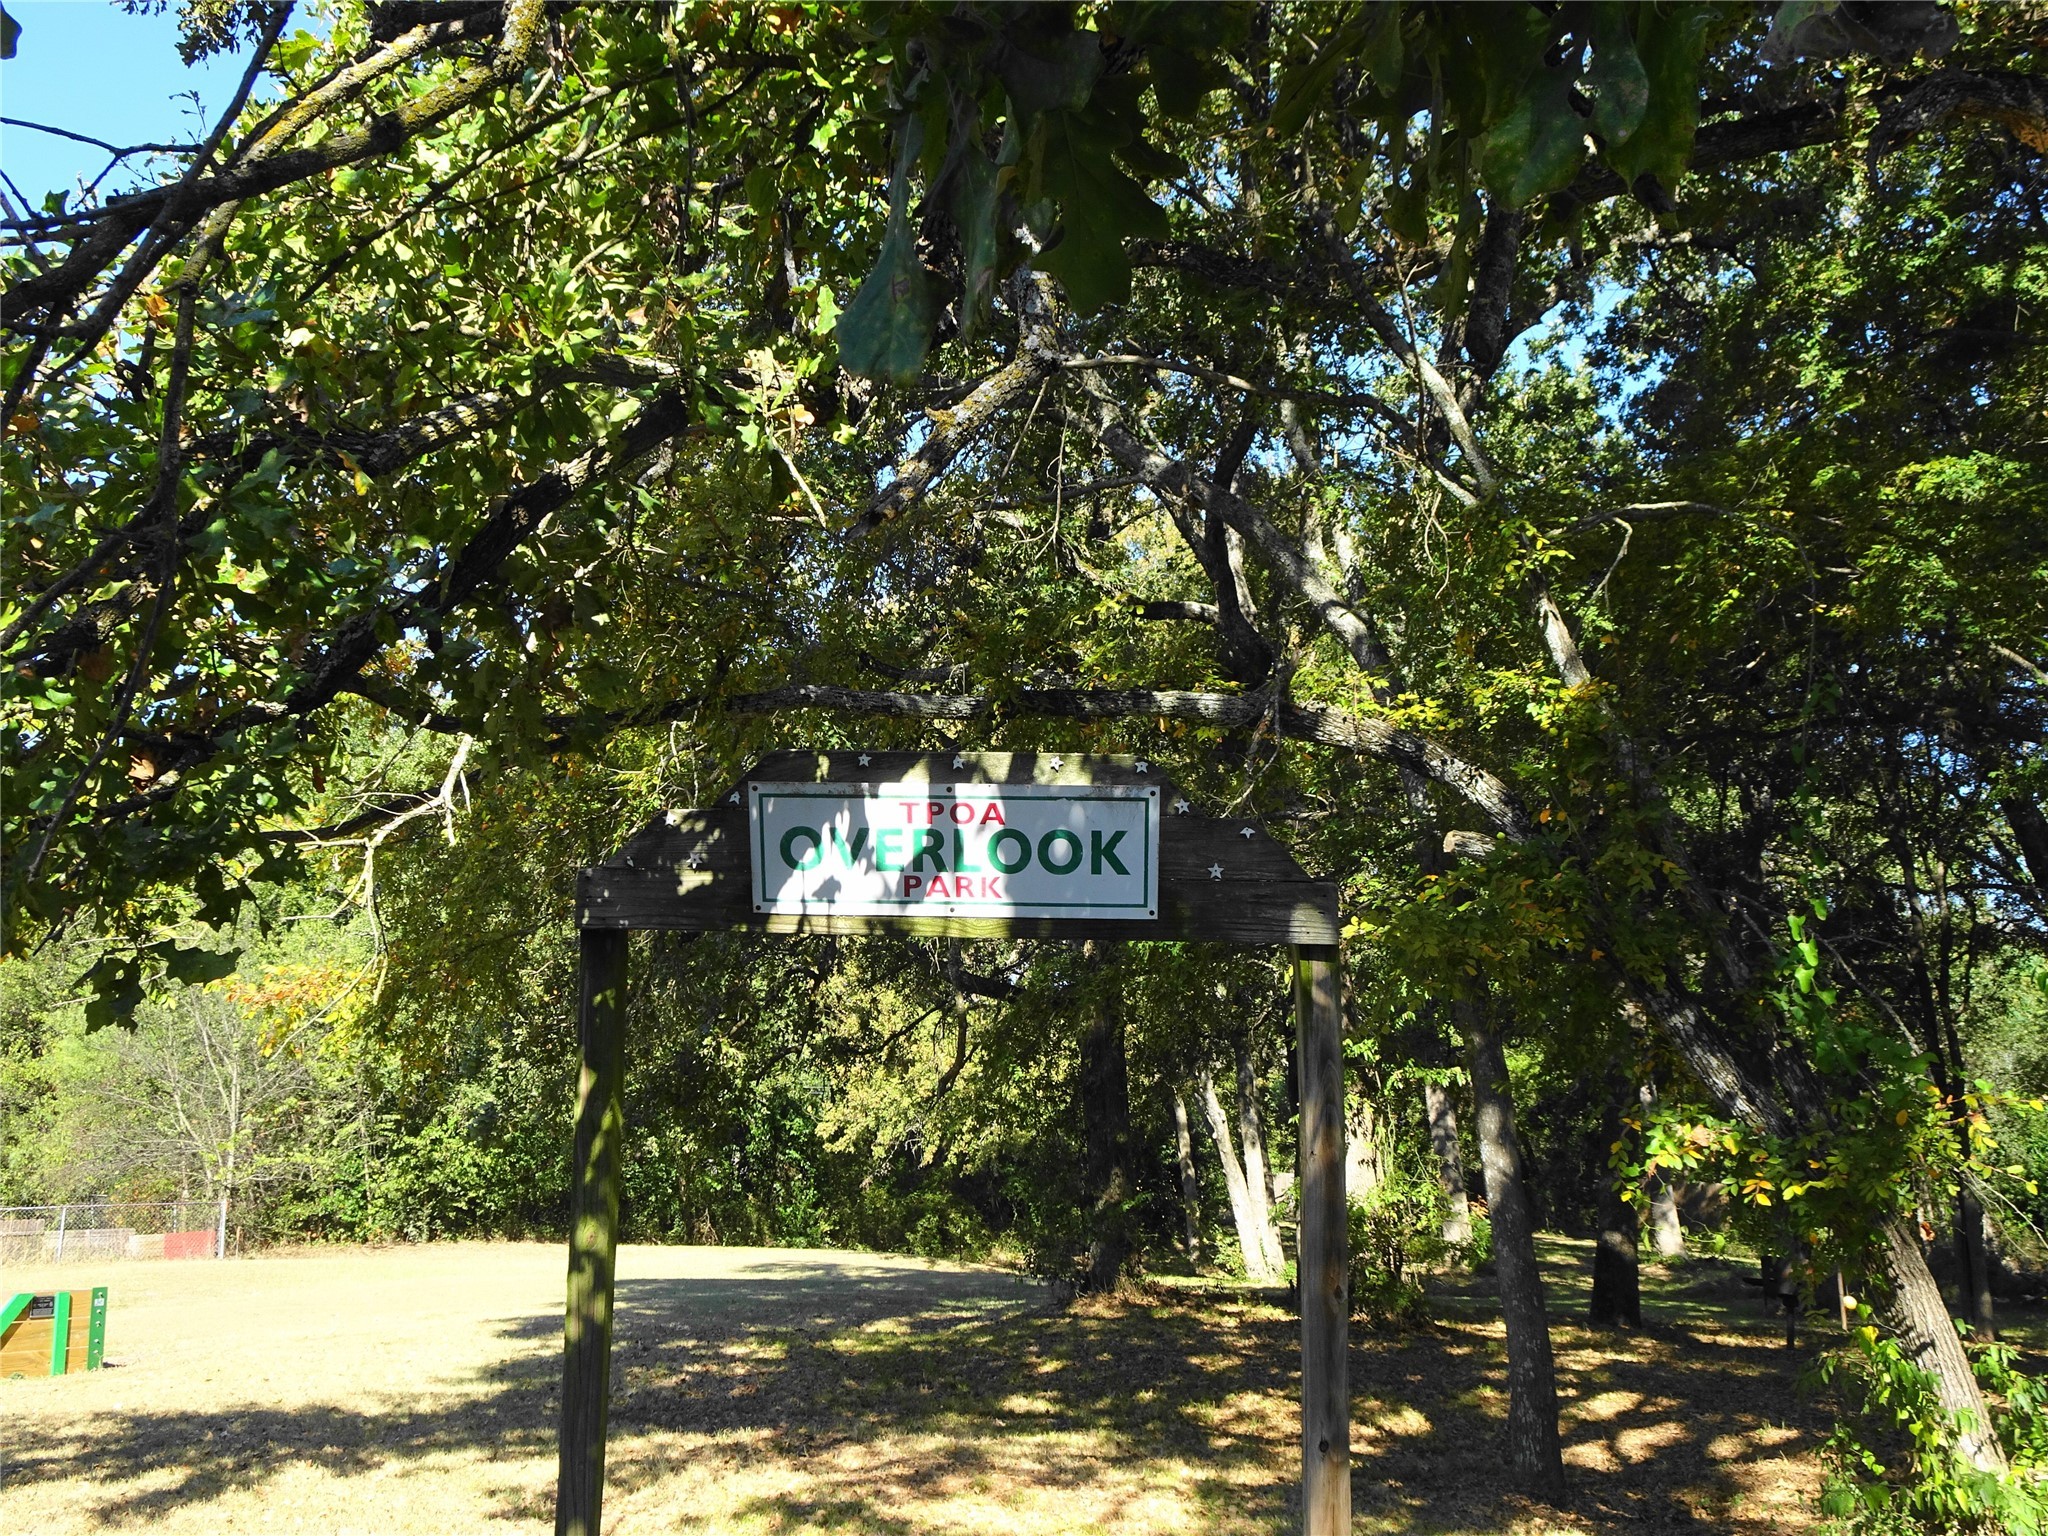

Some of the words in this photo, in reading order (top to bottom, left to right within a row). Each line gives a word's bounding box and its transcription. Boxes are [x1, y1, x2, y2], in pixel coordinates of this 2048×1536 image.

[899, 802, 1005, 825] TPOA
[779, 825, 1131, 875] OVERLOOK
[903, 875, 1003, 899] PARK
